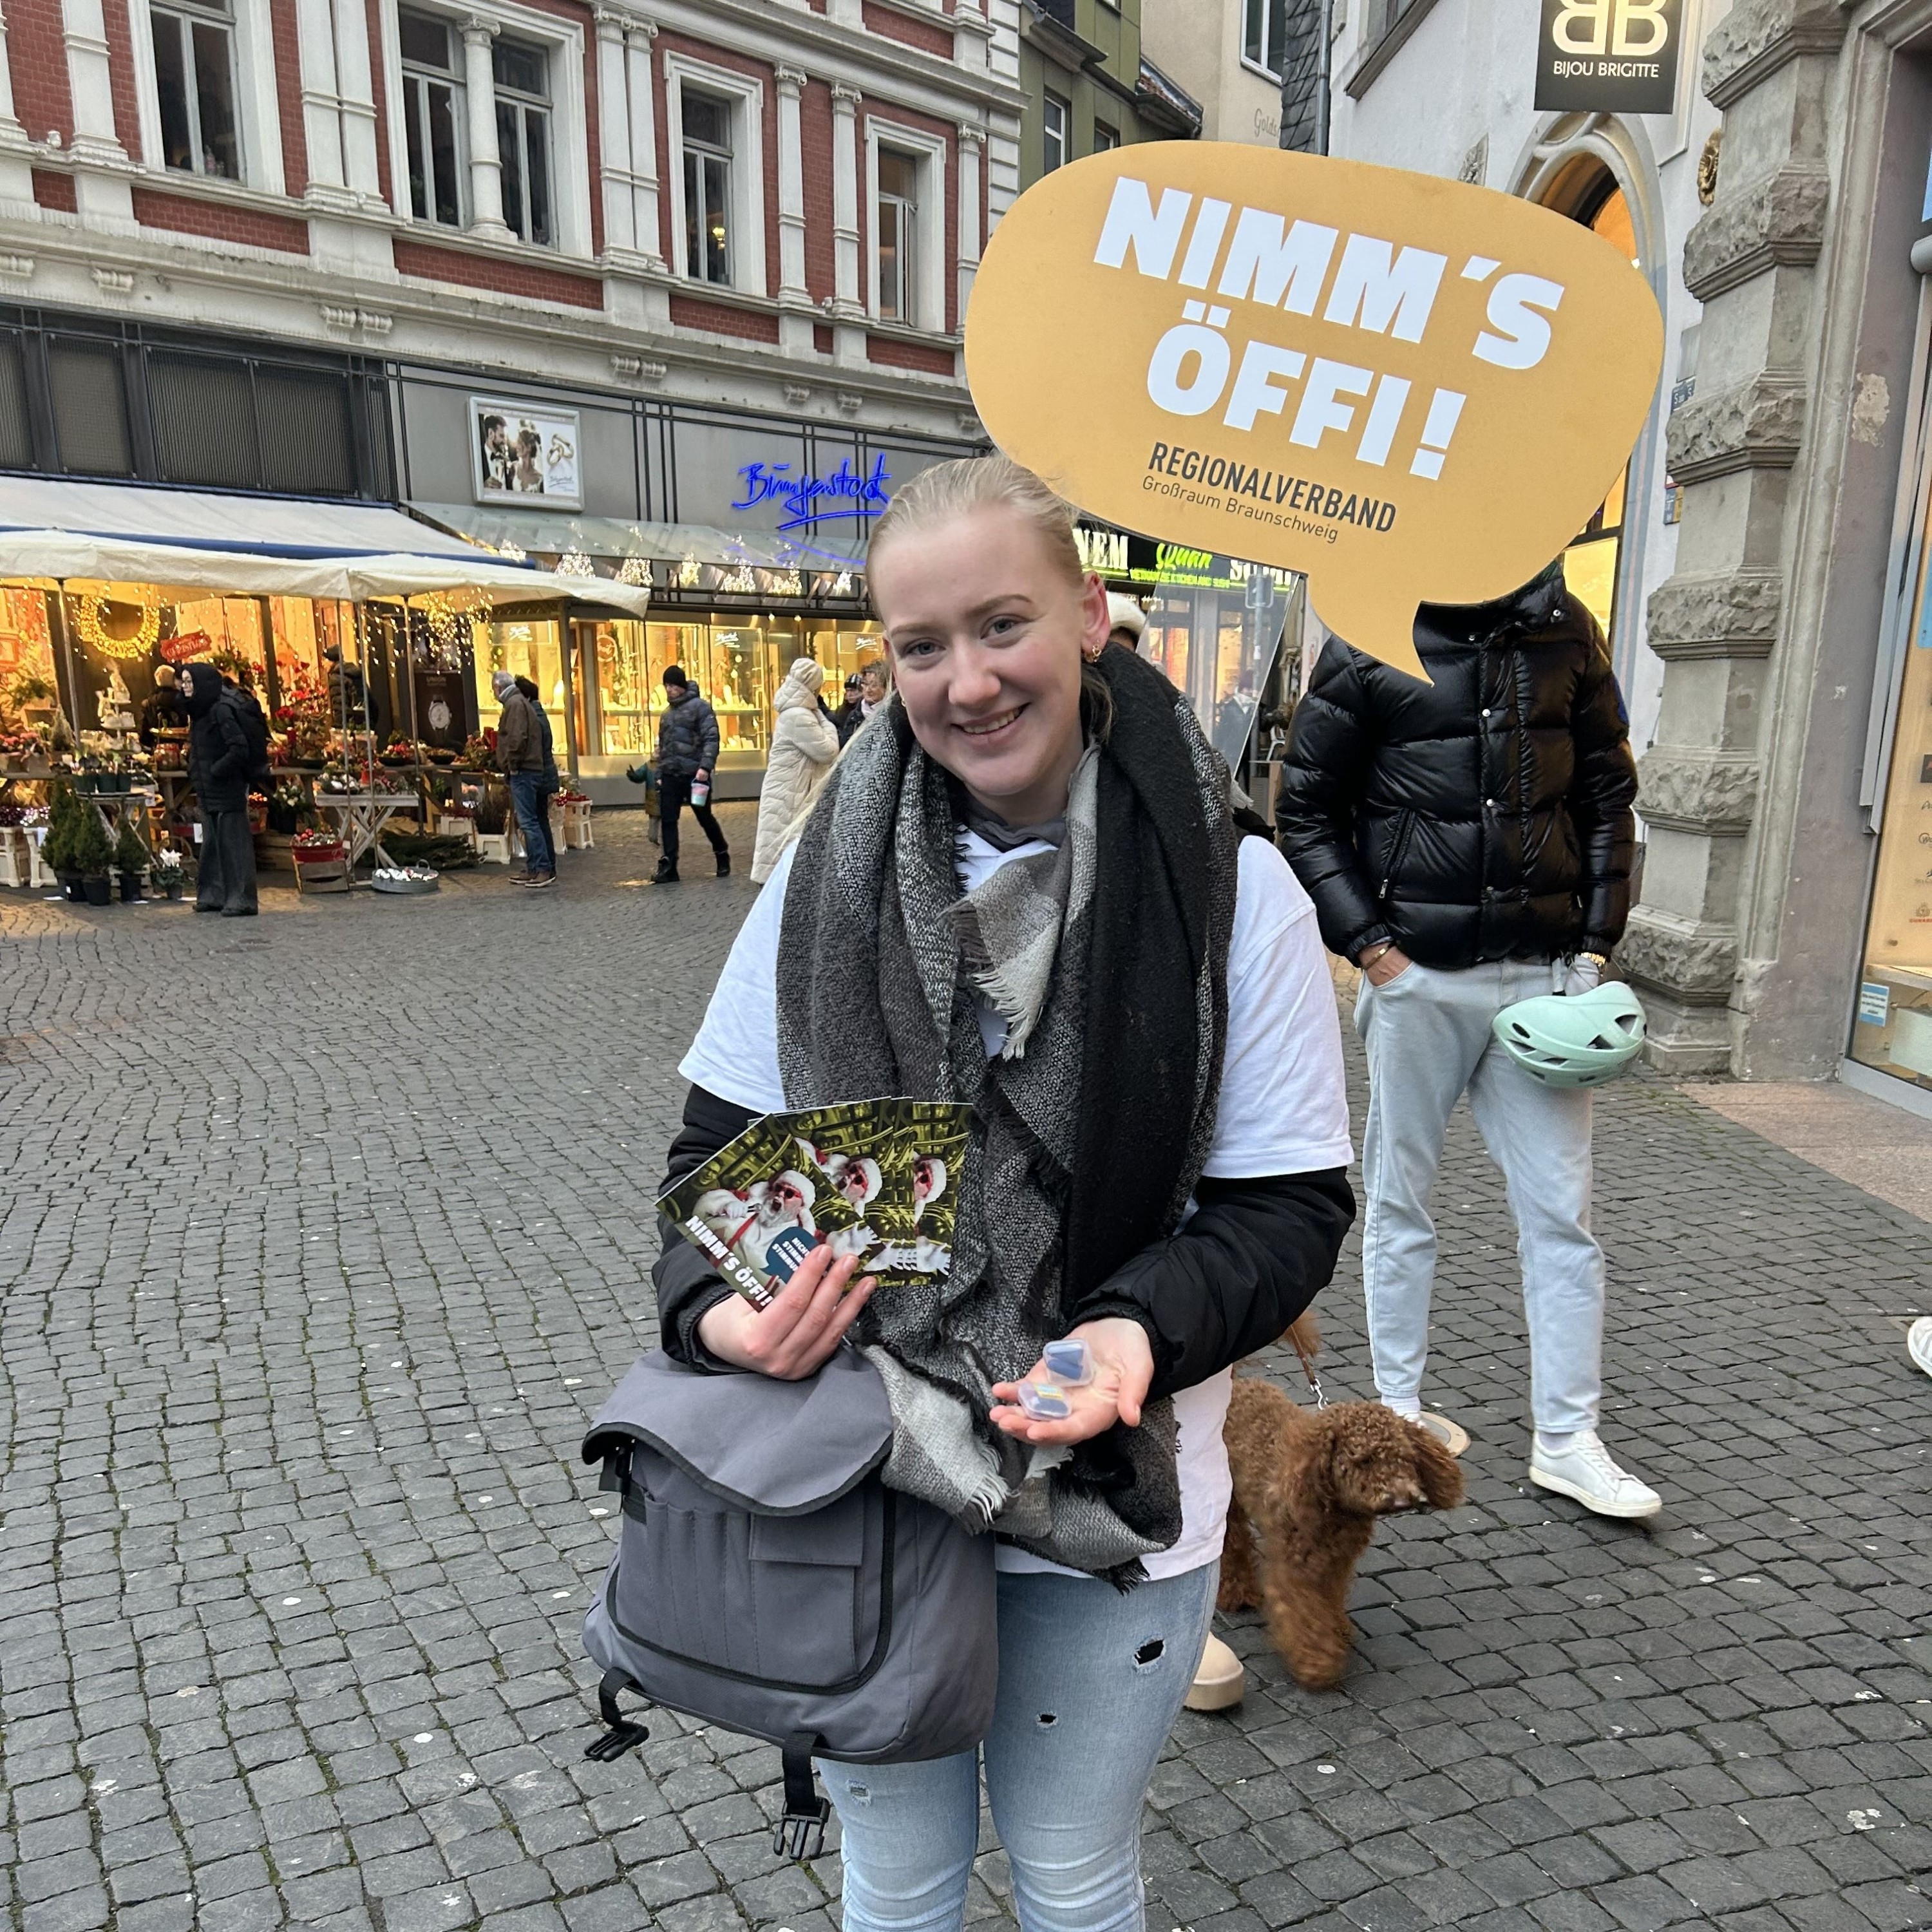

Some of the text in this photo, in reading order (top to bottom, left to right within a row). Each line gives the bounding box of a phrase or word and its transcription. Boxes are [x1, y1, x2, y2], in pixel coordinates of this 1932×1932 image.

[1553, 61, 1660, 78] BIJOU BRIGITTE
[1254, 108, 1279, 138] Golds
[1147, 299, 1466, 480] ÖFFI!
[1148, 442, 1396, 533] REGIONALVERBAND
[1142, 475, 1338, 544] Großraum Braunschweig
[782, 1240, 804, 1263] STIMM
[735, 1266, 774, 1307] ÖFFI!
